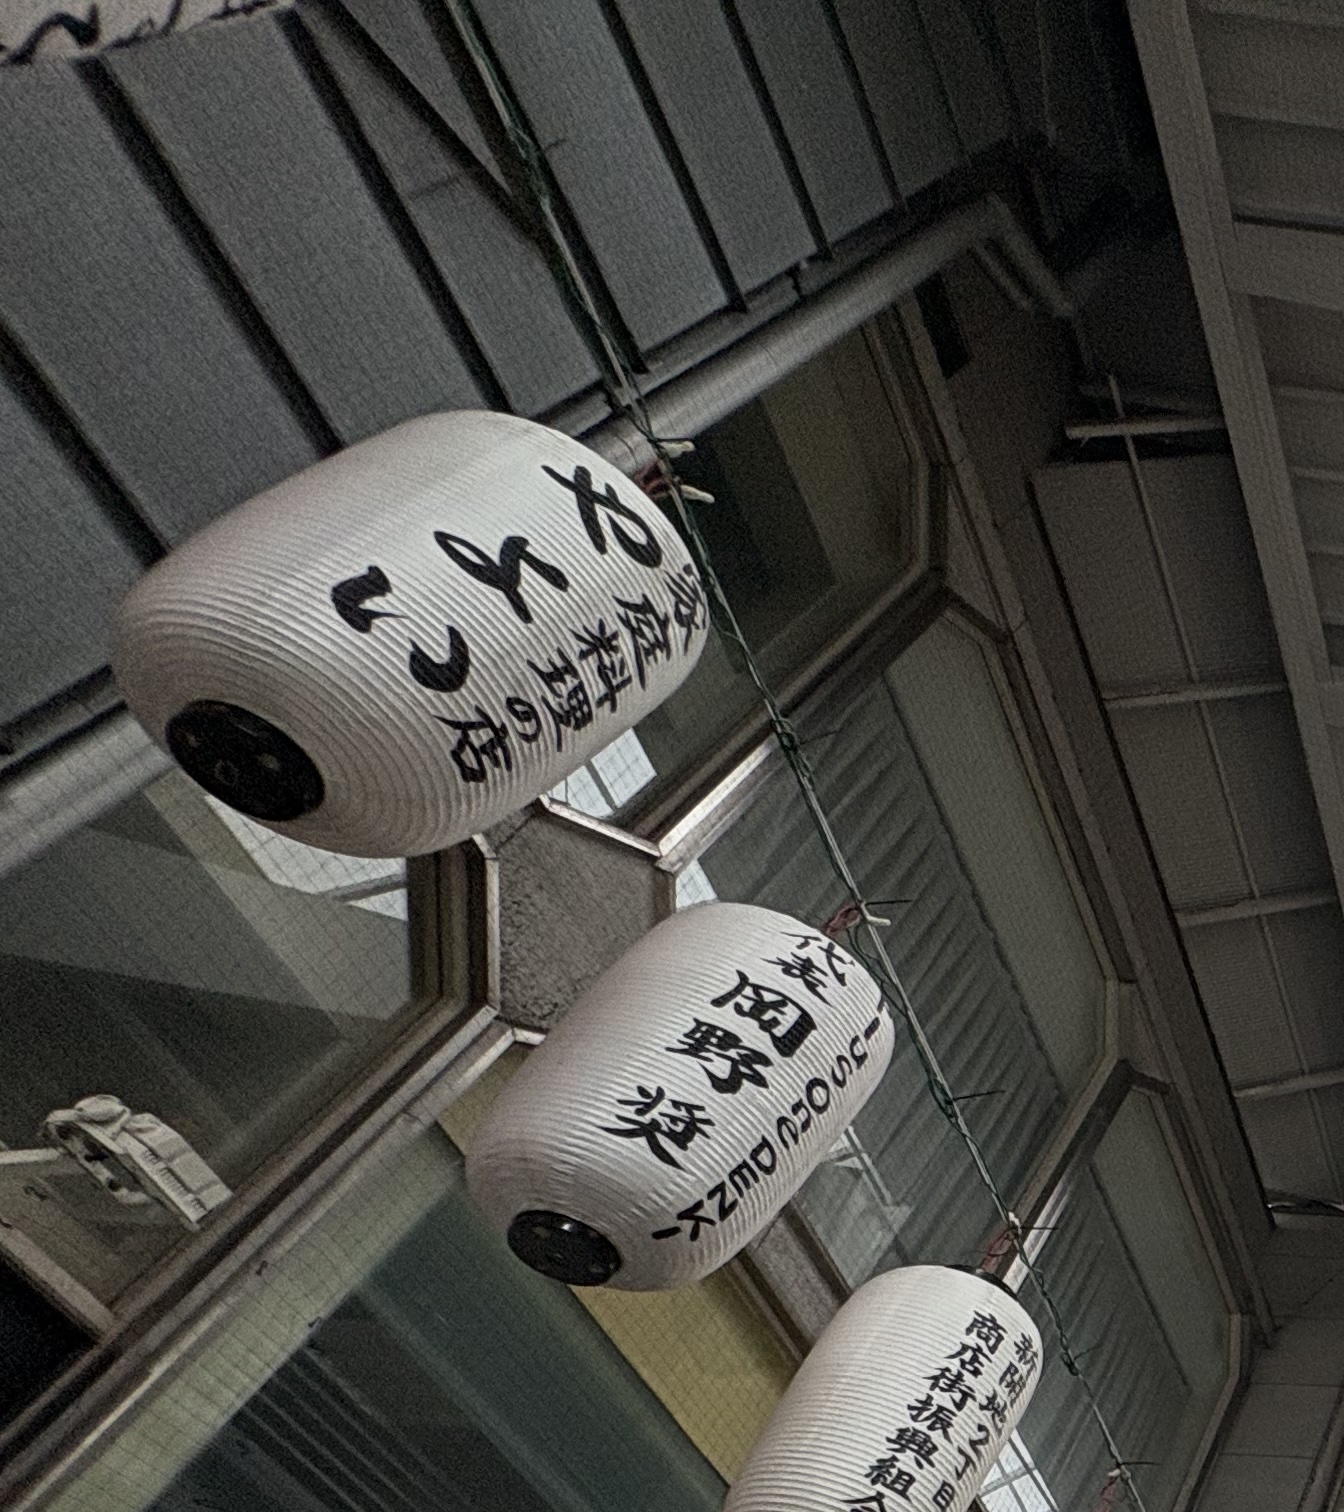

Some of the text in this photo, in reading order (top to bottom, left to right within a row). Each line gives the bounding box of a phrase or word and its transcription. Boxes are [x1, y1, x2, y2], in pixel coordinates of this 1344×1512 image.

[330, 464, 663, 694] やよい
[762, 930, 855, 1003] 代表
